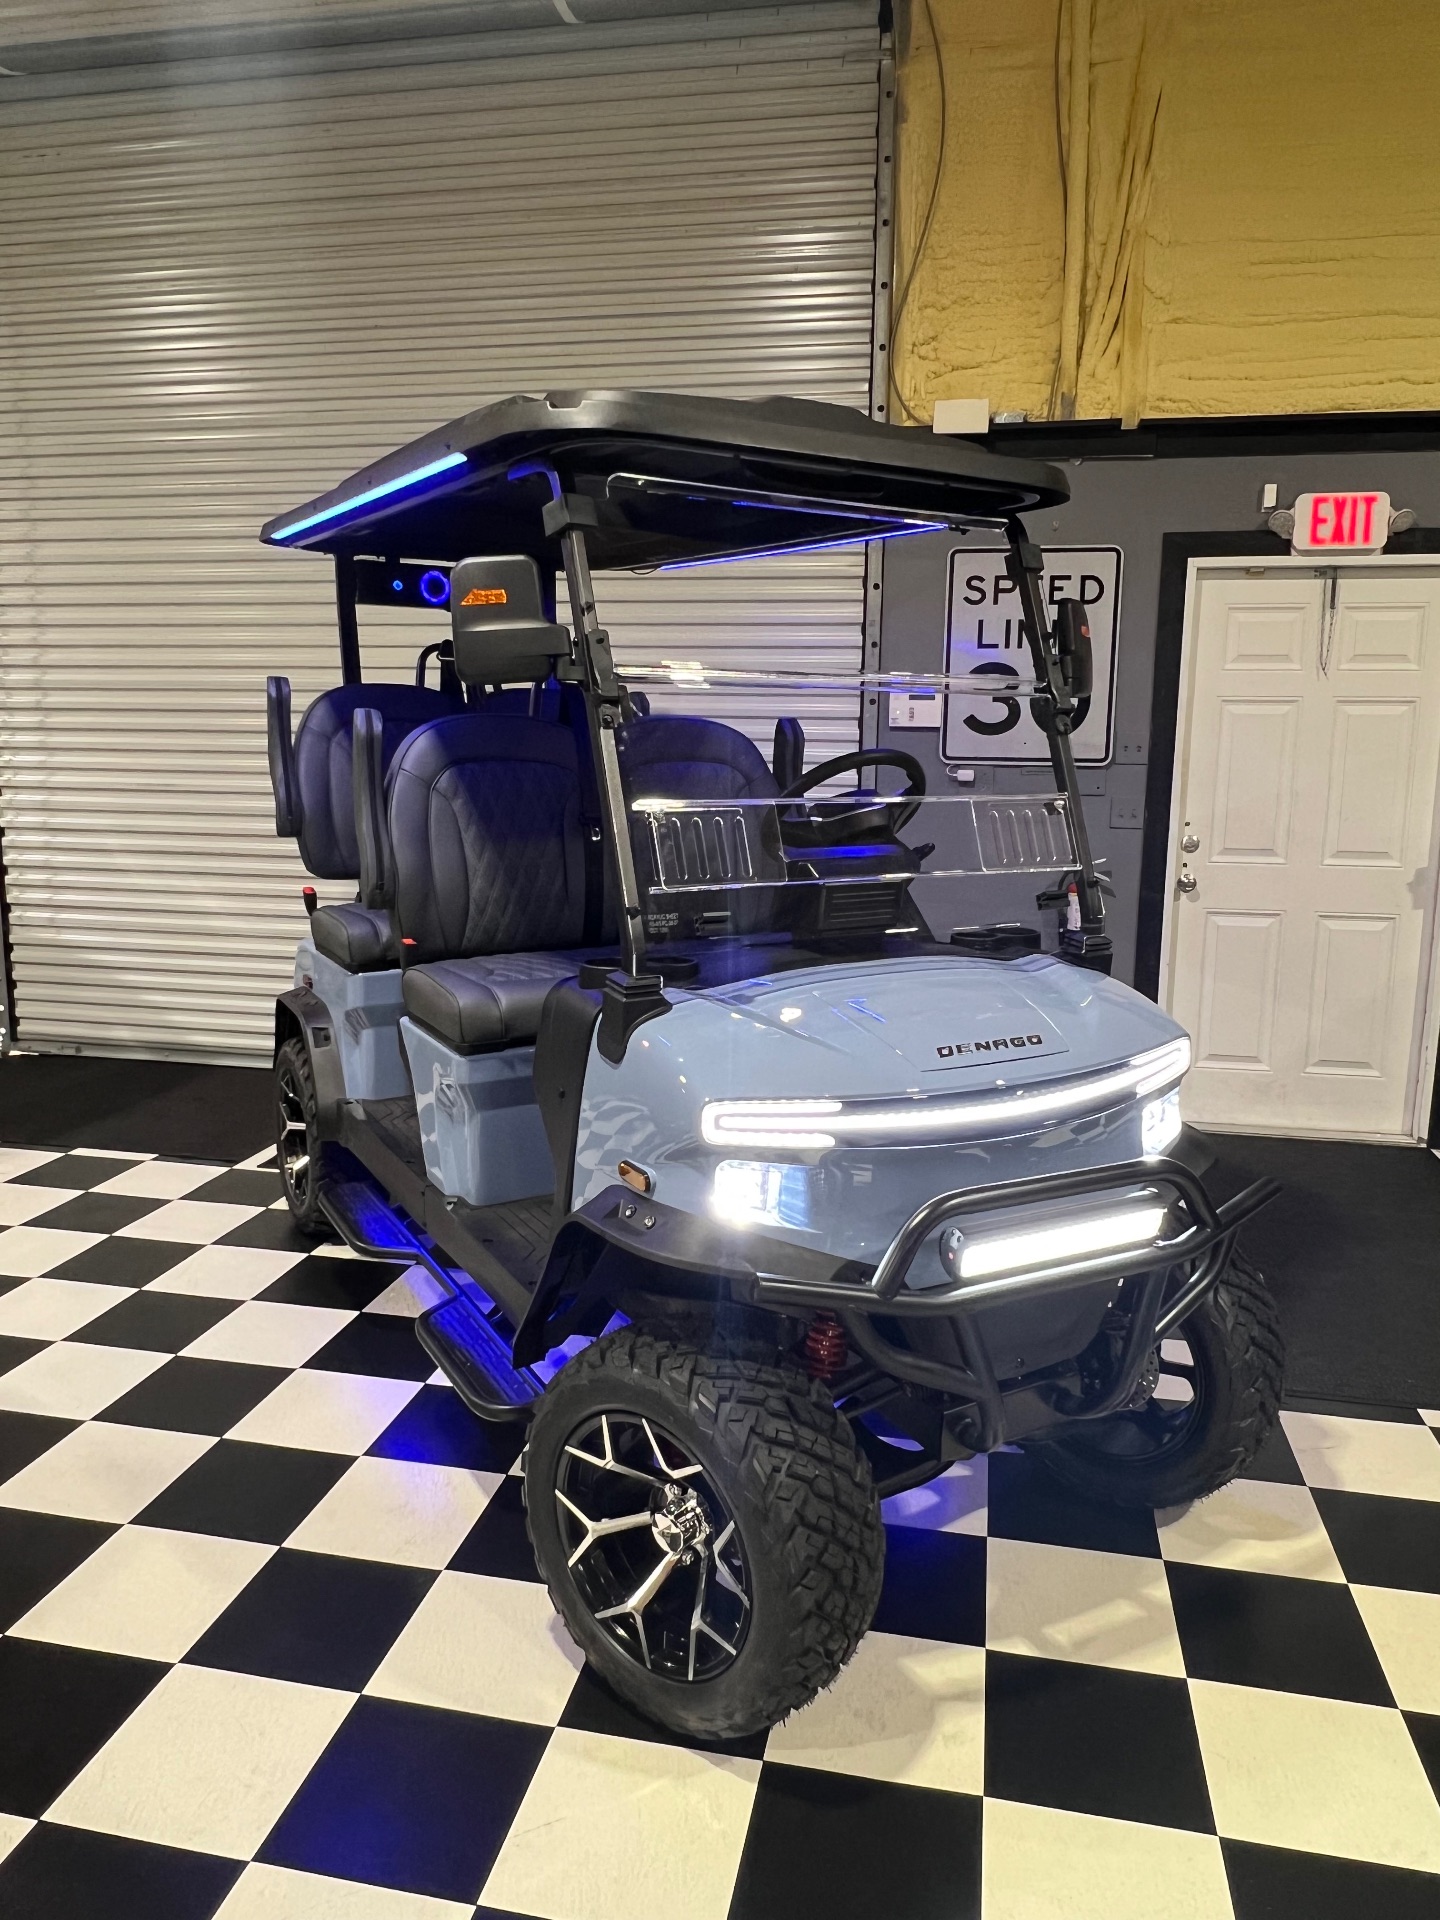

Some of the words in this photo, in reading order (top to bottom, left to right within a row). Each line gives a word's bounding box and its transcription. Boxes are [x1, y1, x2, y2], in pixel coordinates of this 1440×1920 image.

[1309, 495, 1379, 546] EXIT
[962, 574, 1105, 606] SPED
[936, 1034, 1043, 1058] DENAGO
